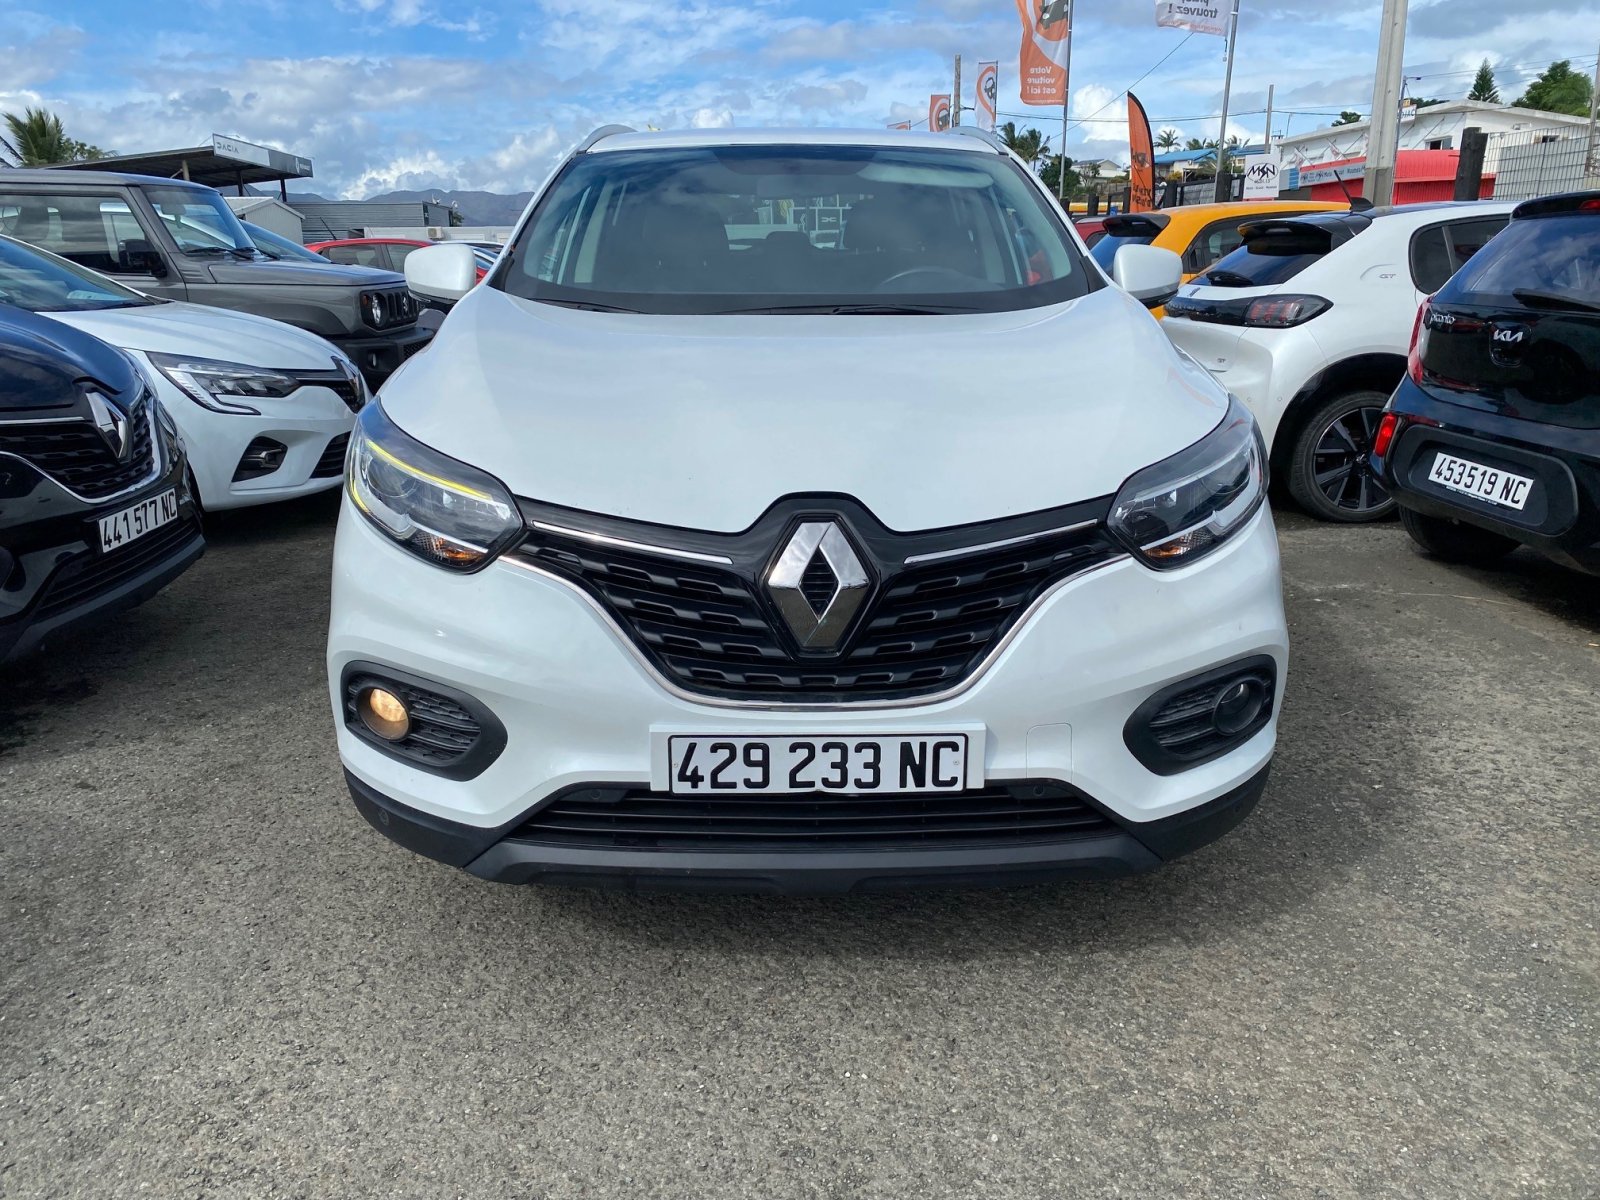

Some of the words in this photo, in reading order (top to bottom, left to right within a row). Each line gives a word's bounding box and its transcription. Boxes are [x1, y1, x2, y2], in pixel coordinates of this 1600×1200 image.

[216, 141, 240, 154] DACIA
[1500, 476, 1527, 505] NC
[103, 512, 131, 548] 441
[133, 499, 158, 535] 577
[160, 491, 177, 522] NC
[677, 742, 771, 789] 429
[788, 741, 882, 789] 233
[899, 741, 960, 788] NC
